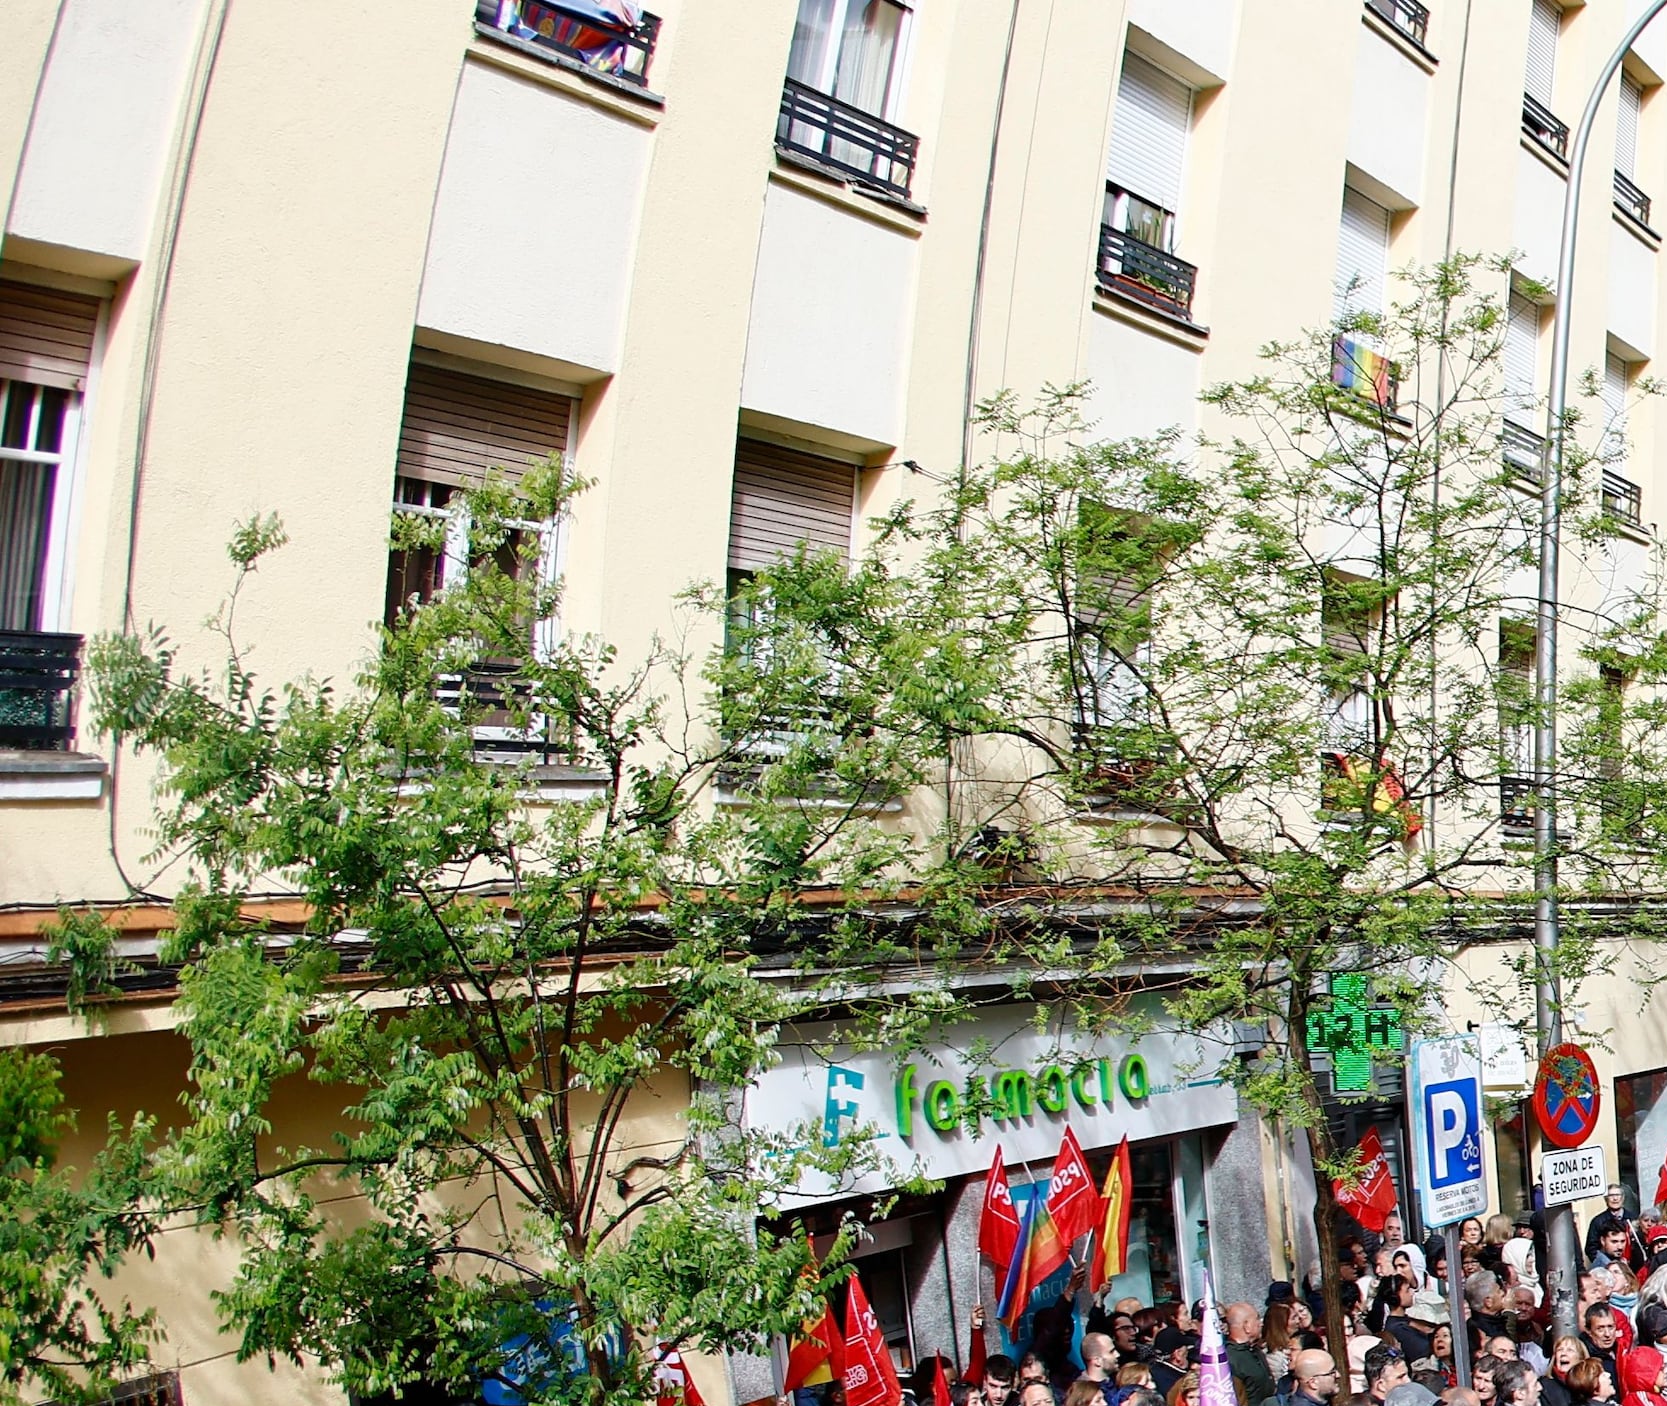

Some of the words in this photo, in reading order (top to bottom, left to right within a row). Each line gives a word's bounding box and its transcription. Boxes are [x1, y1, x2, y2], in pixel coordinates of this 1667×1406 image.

[895, 1053, 1149, 1138] famacia
[1430, 1090, 1467, 1180] P
[1549, 1175, 1601, 1197] SEGURIDAD
[1552, 1160, 1578, 1176] ZONA
[1581, 1156, 1593, 1171] DE
